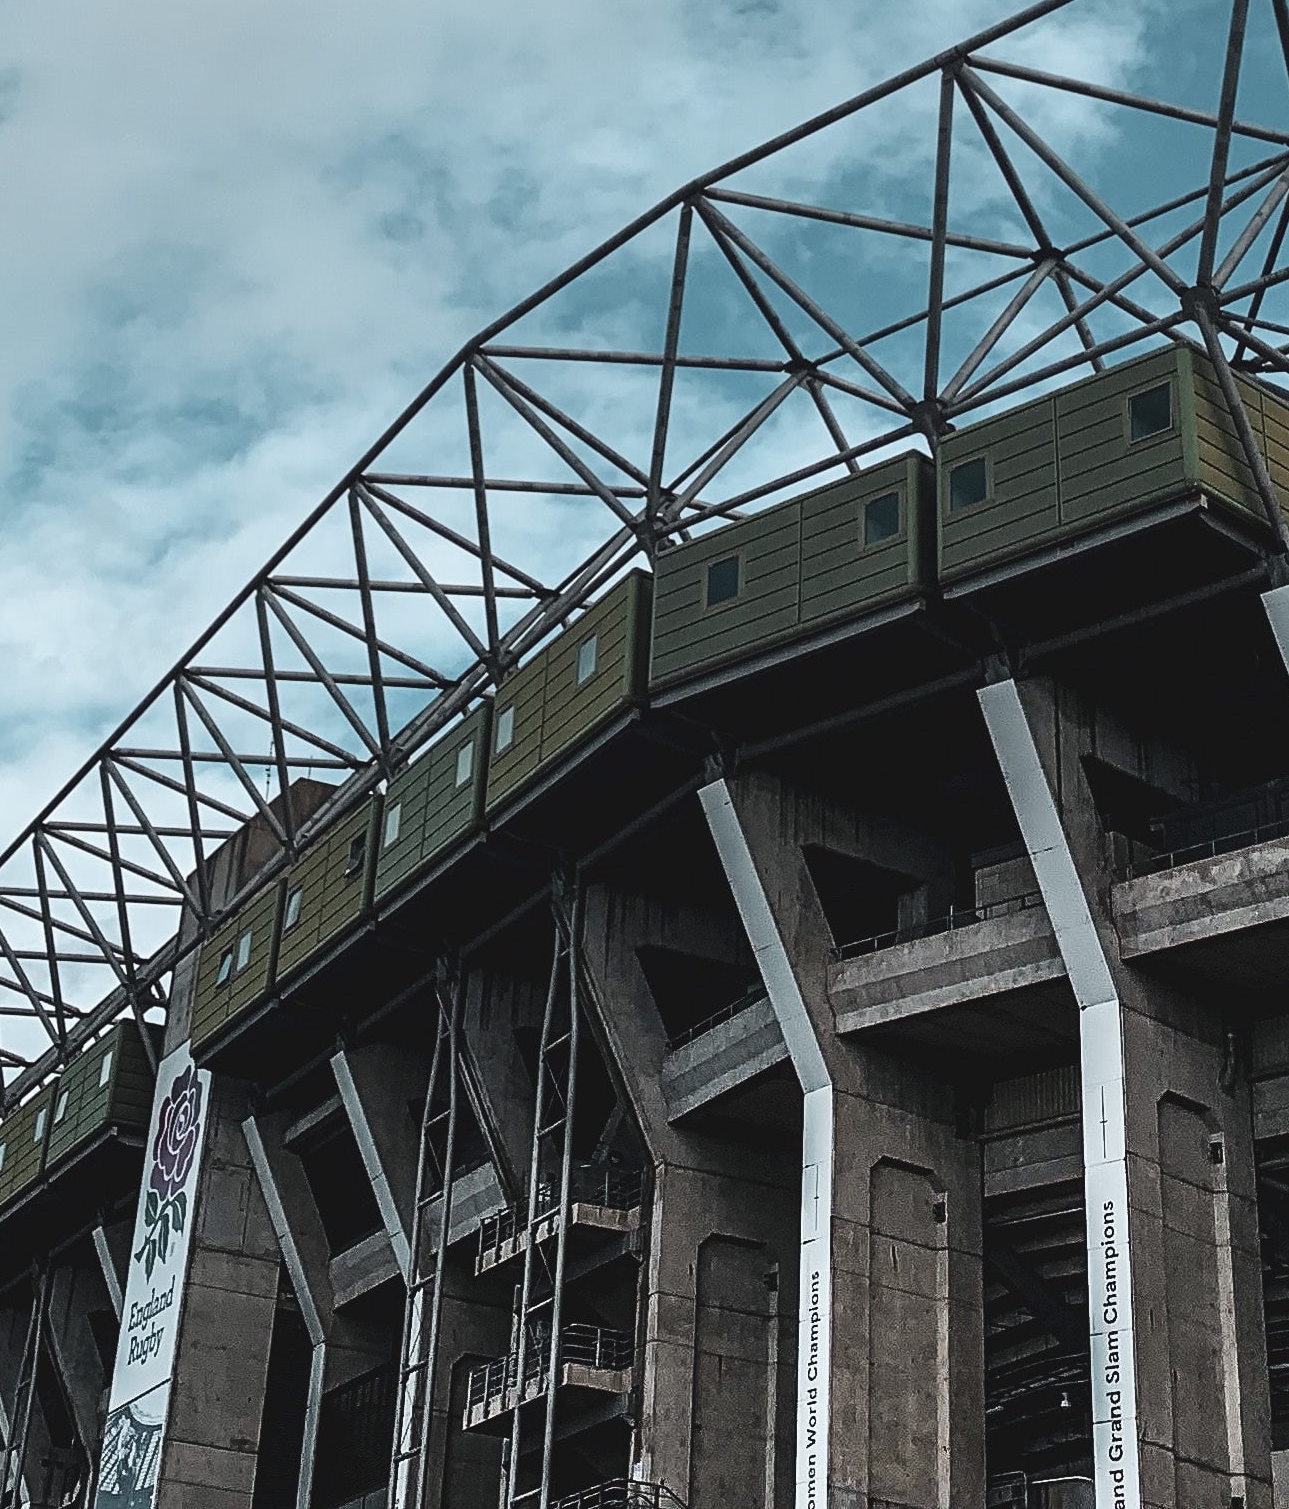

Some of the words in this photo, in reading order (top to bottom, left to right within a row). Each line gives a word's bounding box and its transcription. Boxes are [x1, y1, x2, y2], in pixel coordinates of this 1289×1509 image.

[1100, 1200, 1120, 1325] Champions
[127, 1274, 176, 1333] England
[807, 1271, 821, 1382] Champions
[127, 1321, 165, 1366] Rugby
[1104, 1330, 1120, 1384] Slam
[805, 1387, 818, 1449] World
[1107, 1390, 1125, 1462] Grand
